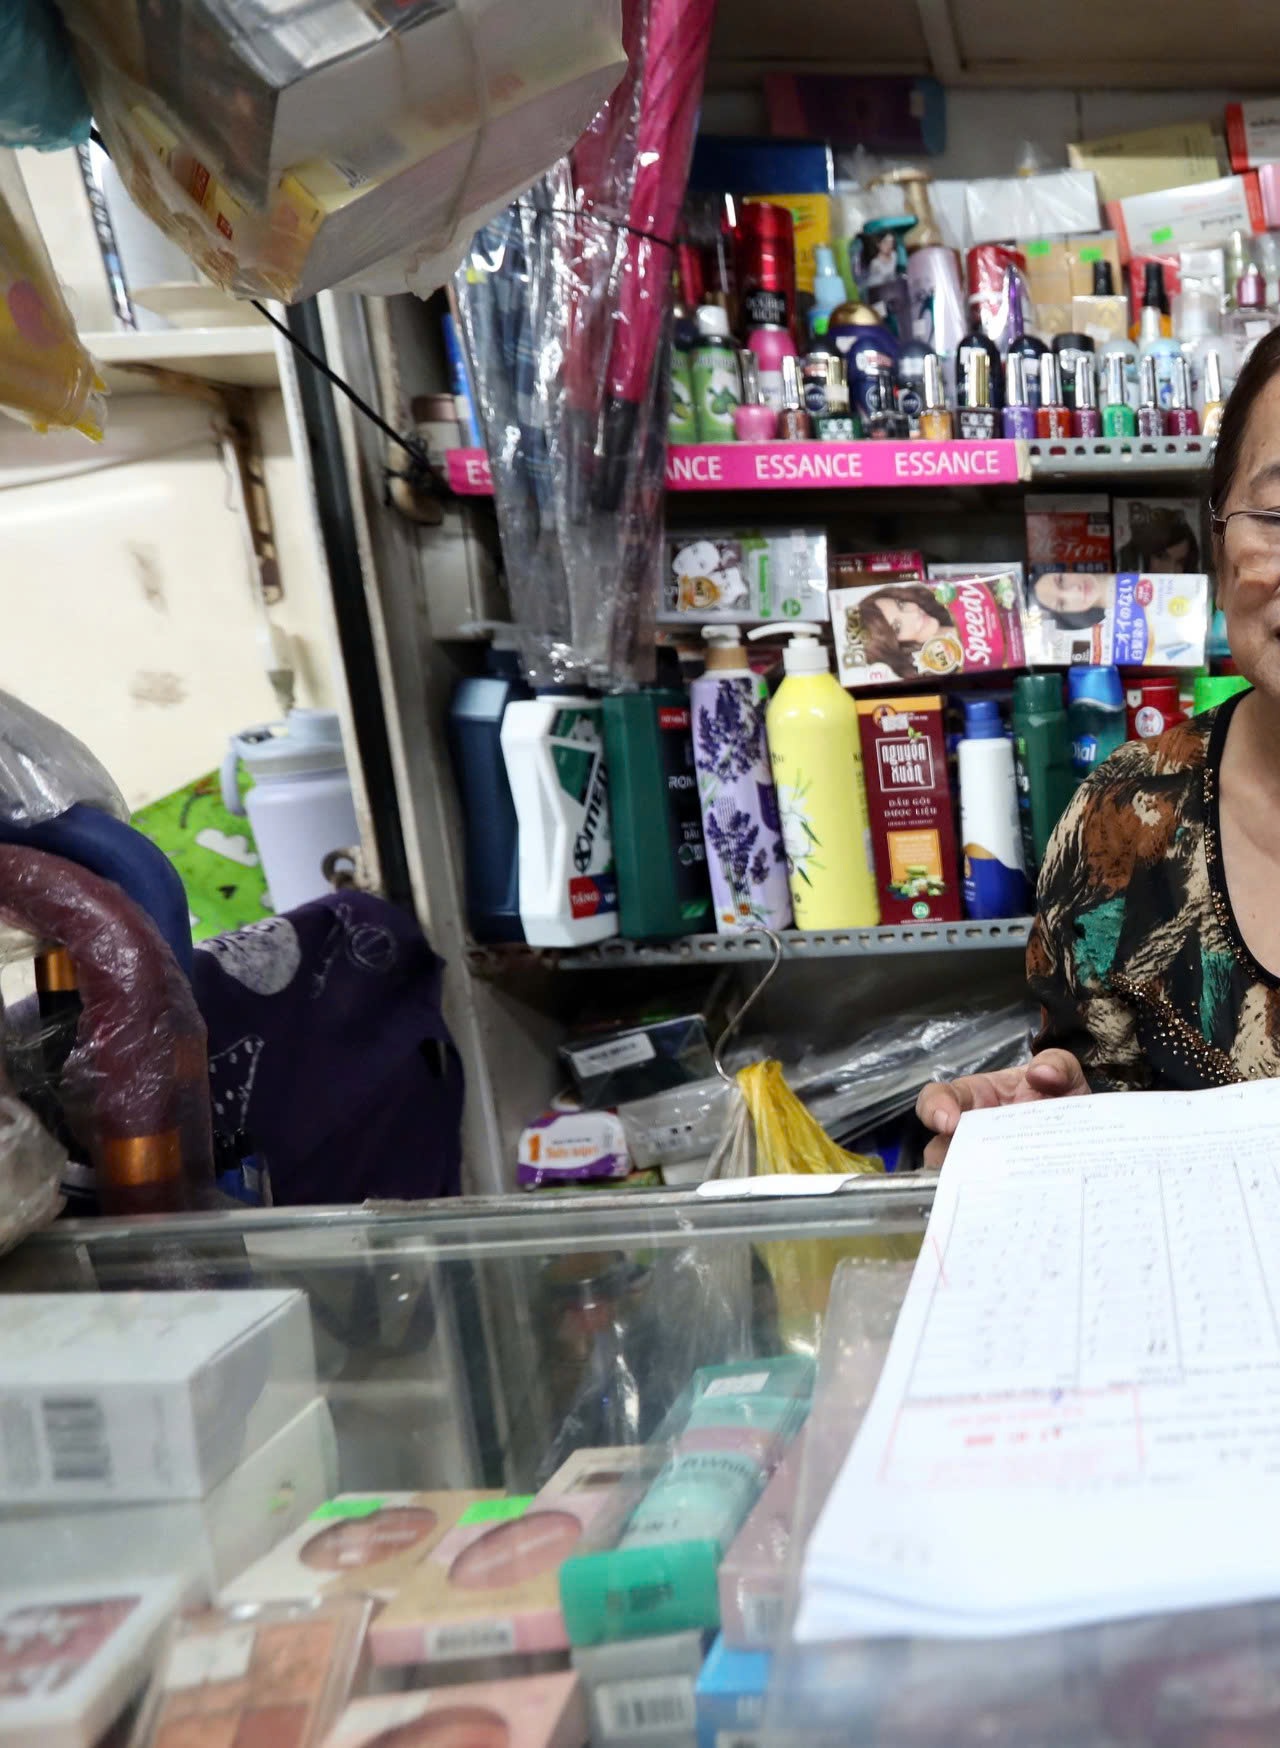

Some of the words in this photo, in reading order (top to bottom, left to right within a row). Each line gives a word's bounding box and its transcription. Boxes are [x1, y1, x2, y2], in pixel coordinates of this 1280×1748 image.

[755, 451, 863, 479] ESSANCE
[894, 449, 1000, 476] ESSANCE
[958, 581, 992, 666] Speedy
